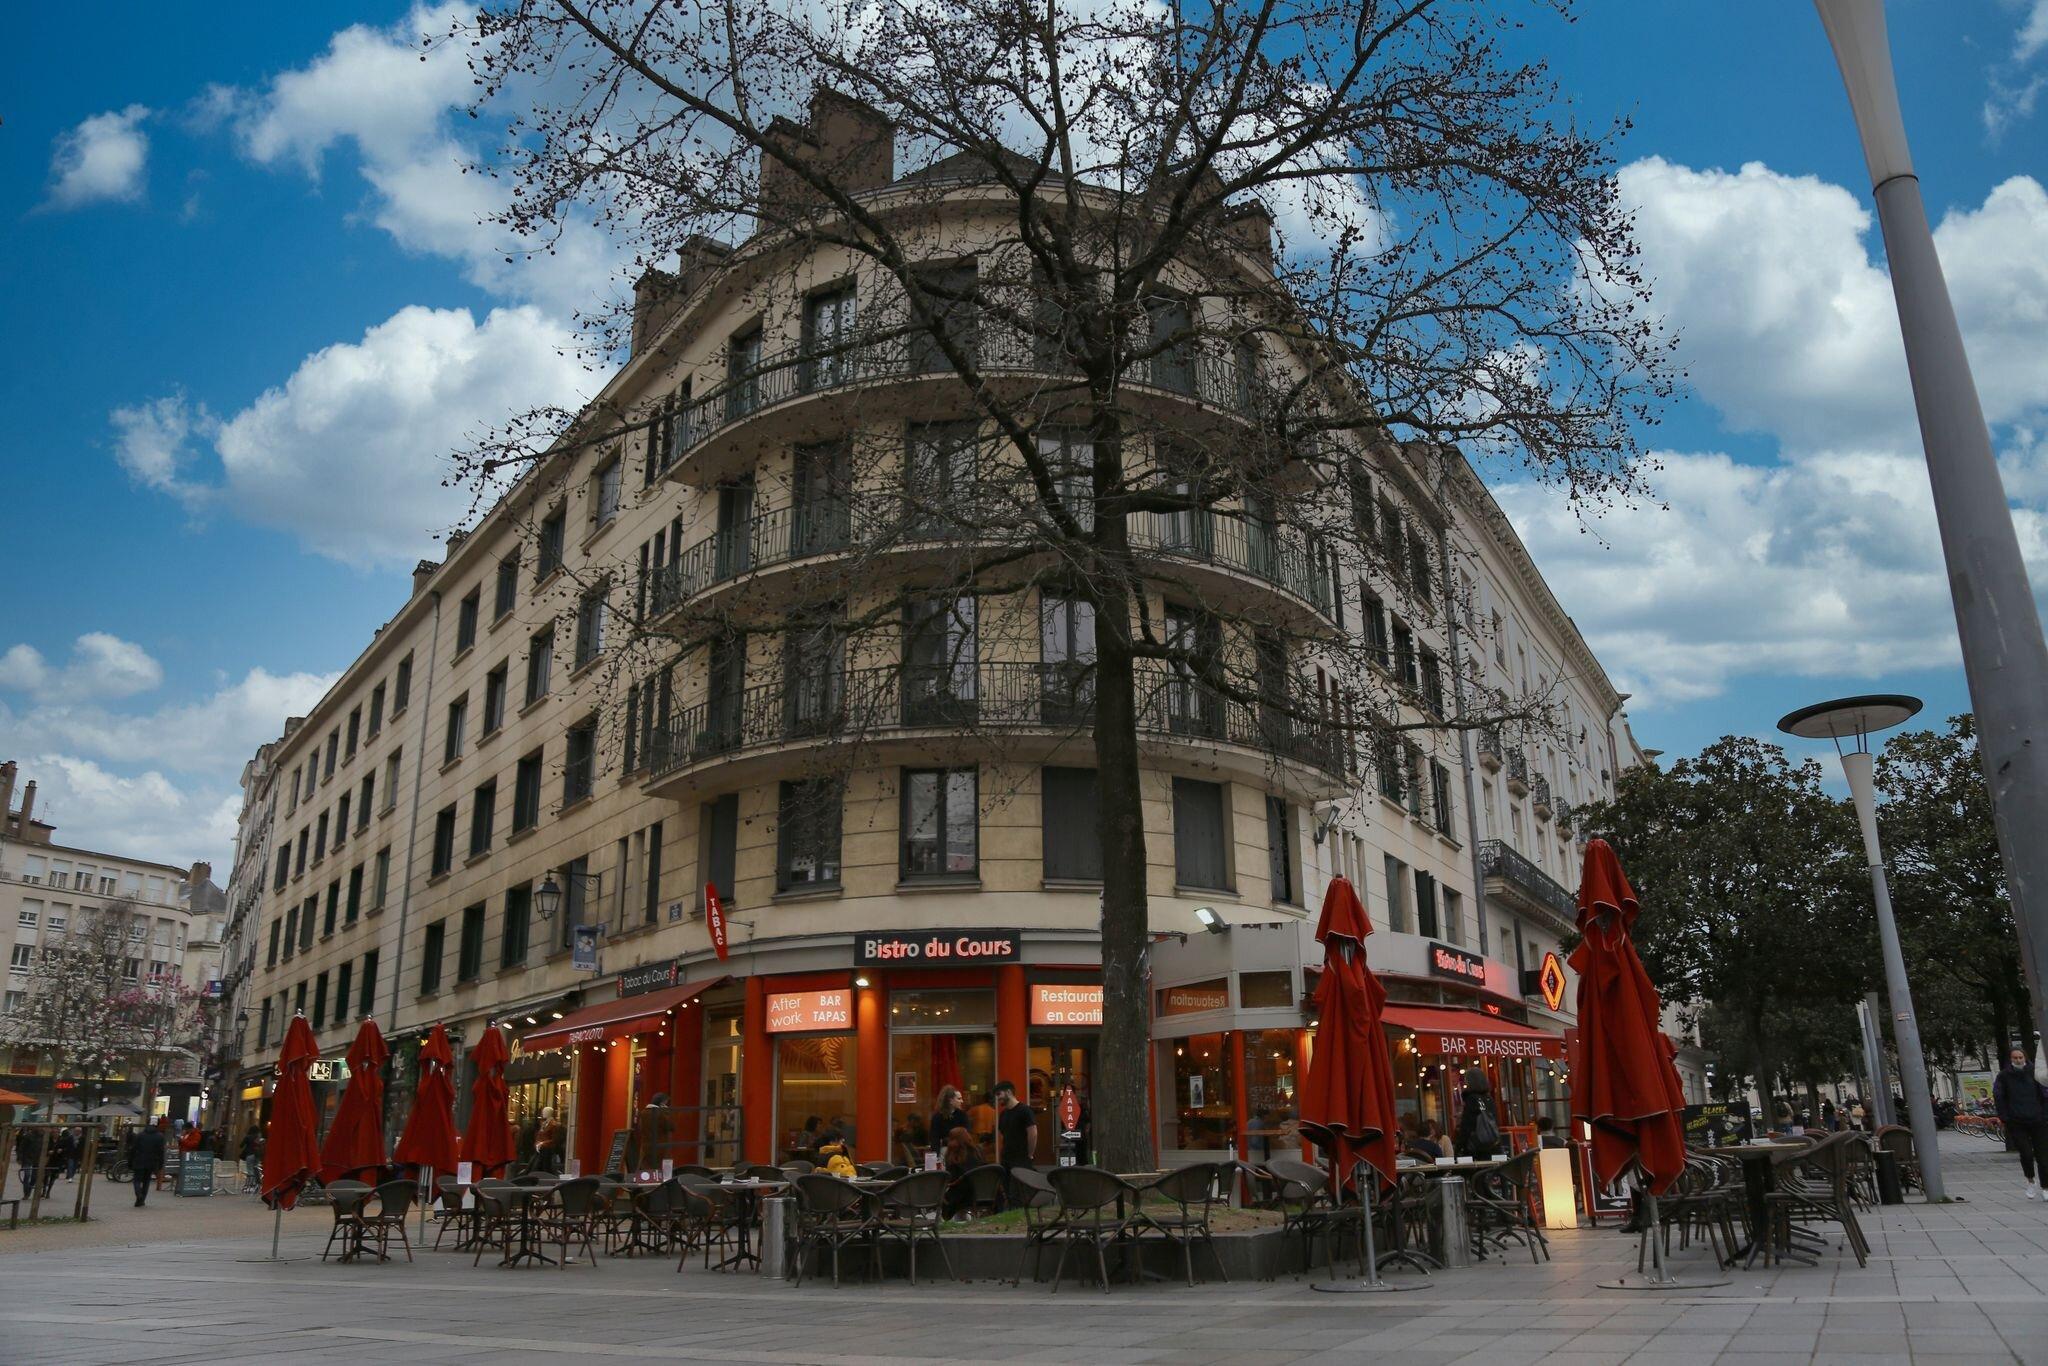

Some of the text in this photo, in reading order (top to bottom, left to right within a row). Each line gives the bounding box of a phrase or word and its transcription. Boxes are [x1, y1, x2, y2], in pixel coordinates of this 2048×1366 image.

[709, 898, 724, 946] TABAC
[864, 937, 1012, 959] Bistro du Cours
[623, 976, 642, 989] Tabac
[643, 972, 651, 984] du
[652, 969, 670, 983] Cours
[771, 997, 802, 1013] After
[820, 995, 841, 1006] BAR
[771, 1012, 803, 1027] work
[813, 1011, 847, 1022] TAPAS
[1047, 1011, 1064, 1022] en
[1441, 1037, 1467, 1053] BAR
[1476, 1039, 1543, 1057] BRASSERIE
[1066, 1089, 1074, 1129] TABAC
